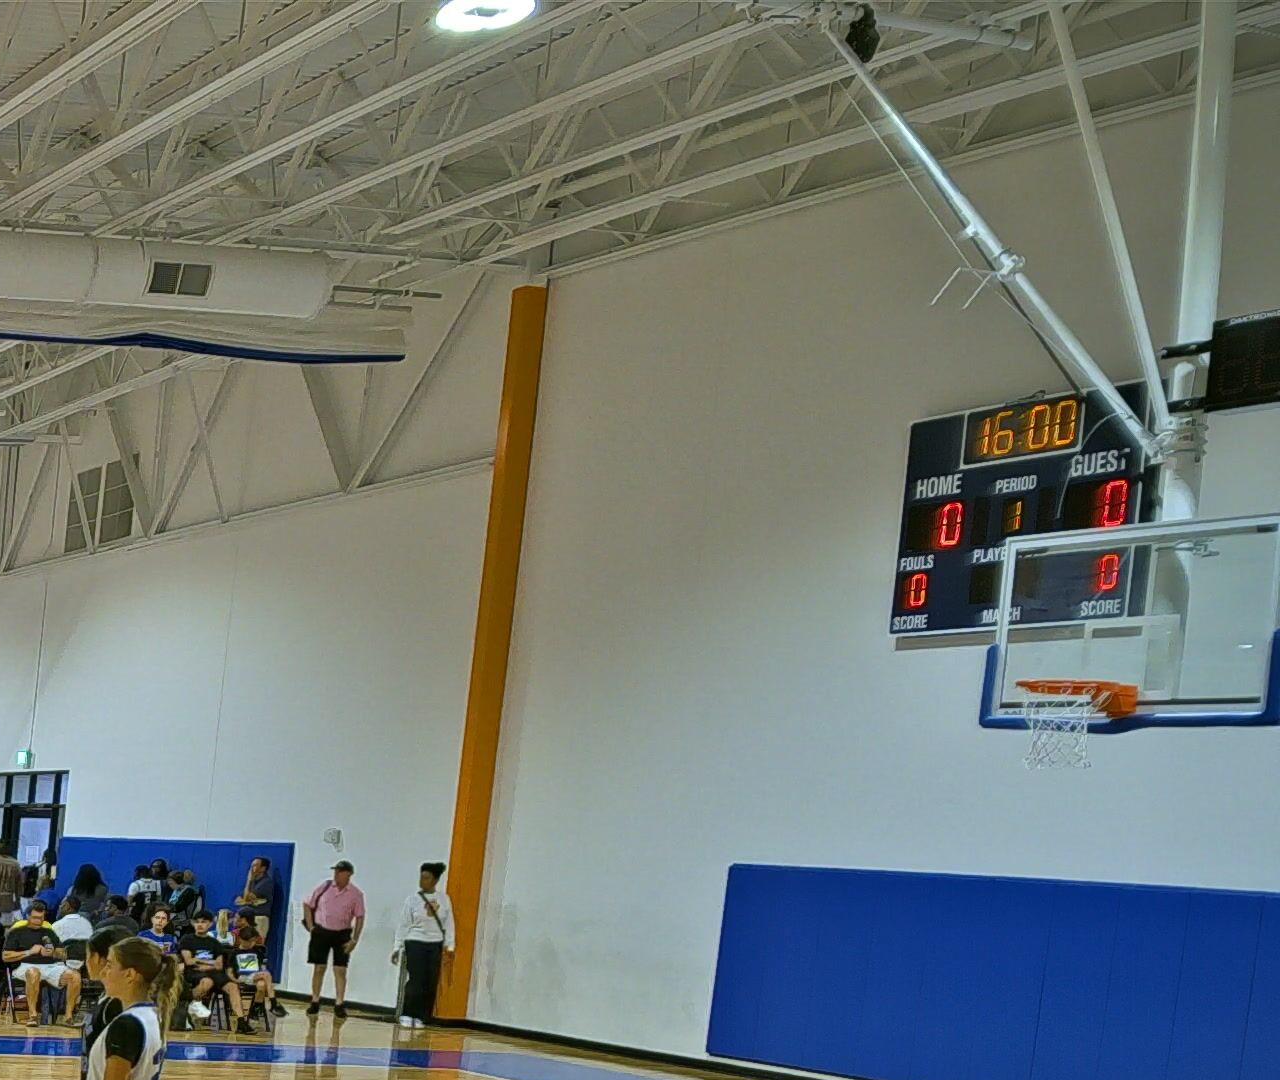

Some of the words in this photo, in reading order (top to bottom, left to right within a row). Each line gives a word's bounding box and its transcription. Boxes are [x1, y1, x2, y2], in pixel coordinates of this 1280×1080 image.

[977, 400, 1076, 456] 16:00
[1071, 448, 1131, 477] GUEST
[915, 474, 963, 499] HOME
[995, 474, 1038, 494] PERIOD
[1103, 480, 1128, 526] 0
[940, 502, 963, 546] 0
[899, 554, 934, 571] FOULS
[1099, 554, 1119, 590] 0
[910, 573, 928, 606] 0
[982, 607, 1021, 624] MACH
[1080, 599, 1121, 616] SCORE
[892, 614, 928, 630] SCORE
